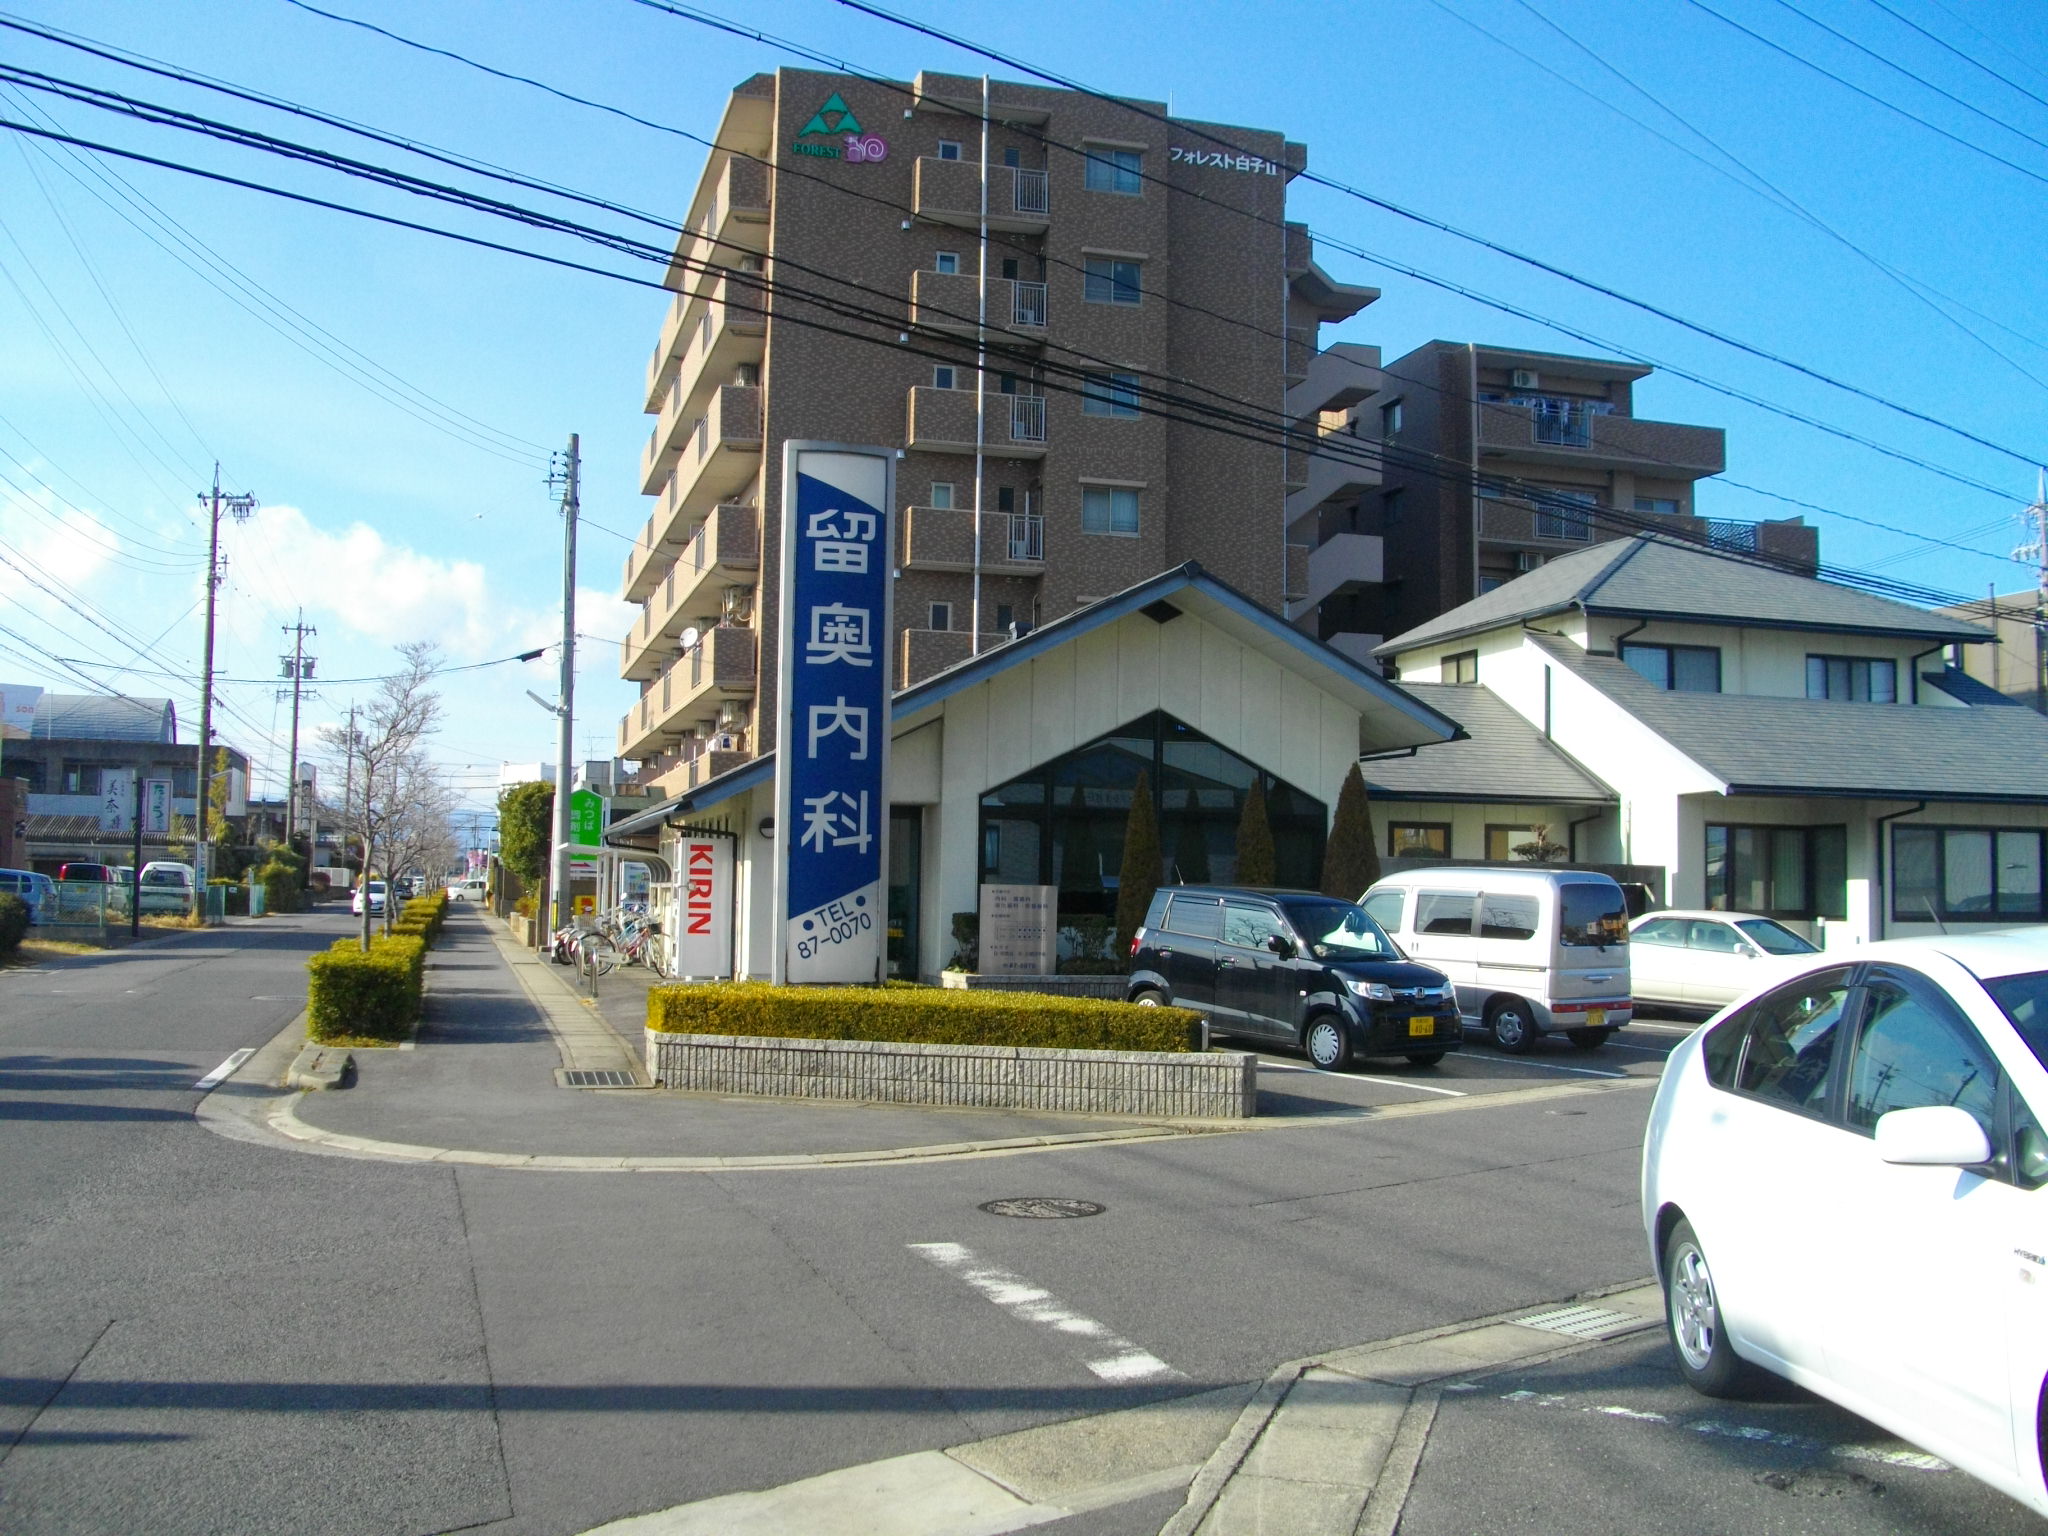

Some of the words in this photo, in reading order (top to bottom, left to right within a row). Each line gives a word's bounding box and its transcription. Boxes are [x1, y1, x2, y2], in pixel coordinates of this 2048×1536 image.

[793, 143, 841, 158] FOREST
[687, 844, 714, 934] KIRIN
[814, 901, 854, 927] TEL
[797, 912, 871, 959] 87-0070
